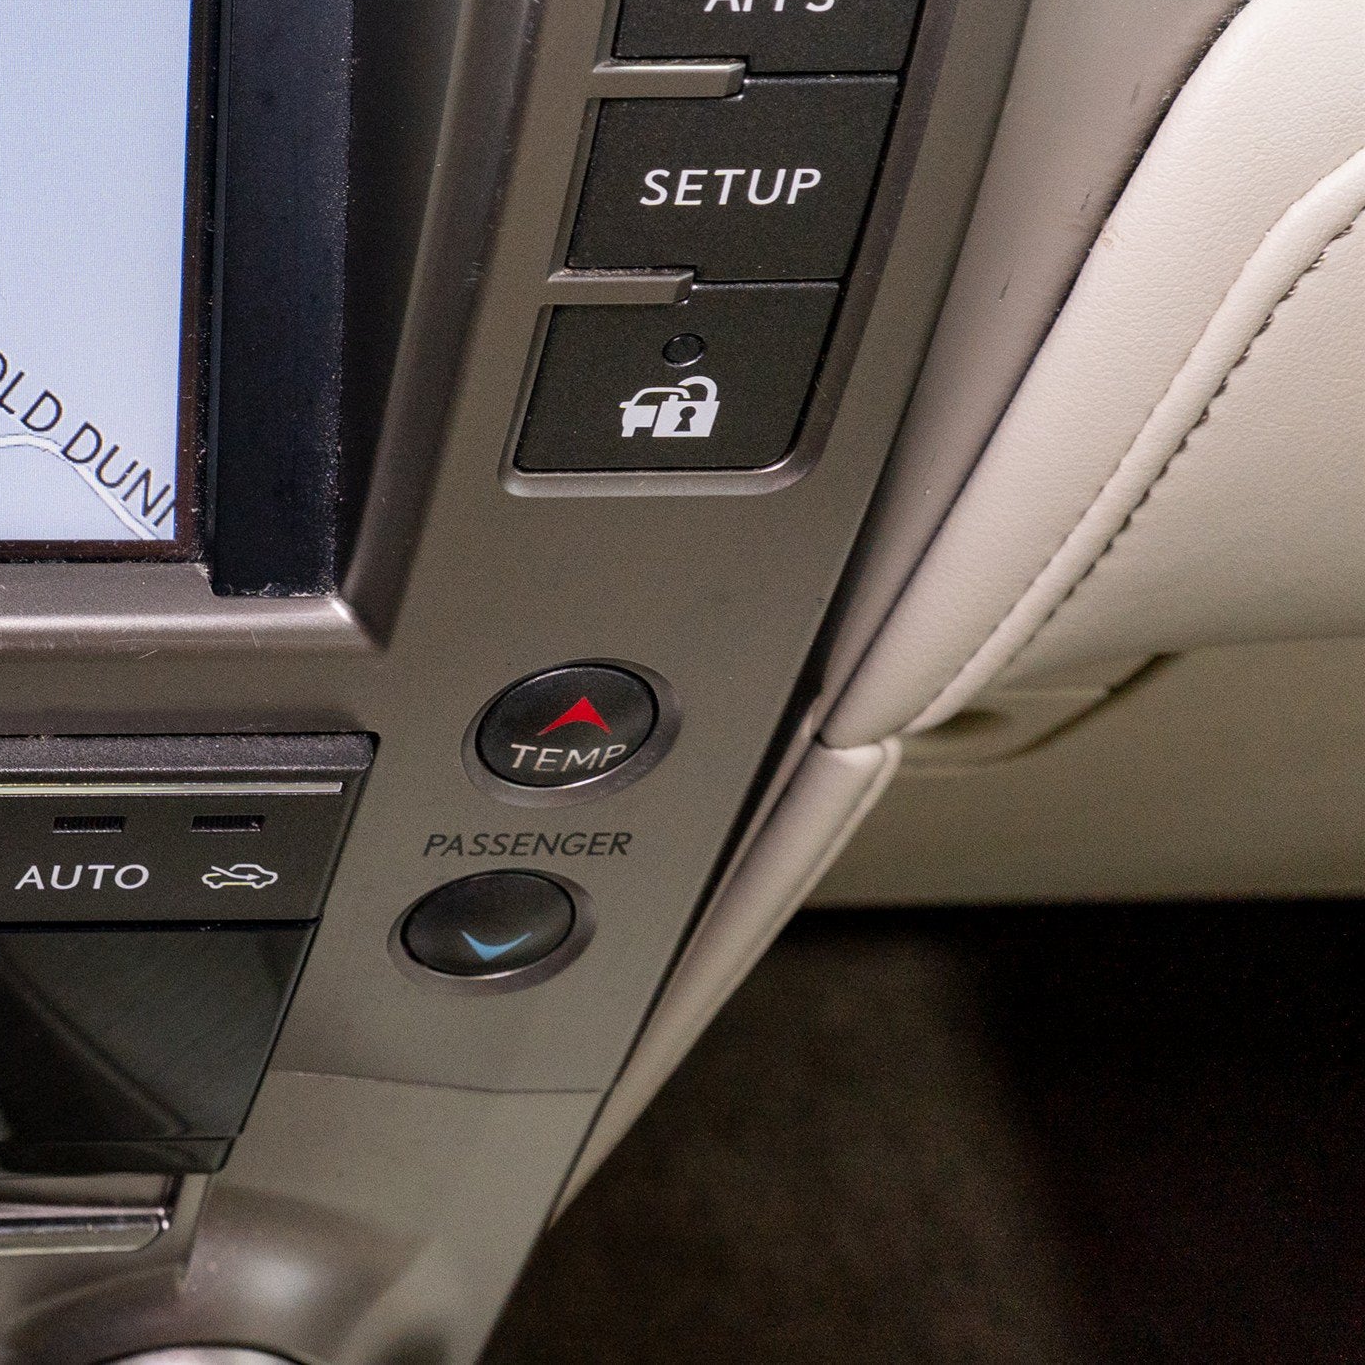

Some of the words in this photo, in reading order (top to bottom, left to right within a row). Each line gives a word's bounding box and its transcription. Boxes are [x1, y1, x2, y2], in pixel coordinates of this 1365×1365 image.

[640, 169, 821, 205] SETUP
[509, 743, 627, 774] TEMP
[423, 832, 632, 857] PASSENGER
[15, 865, 149, 889] AUTO
